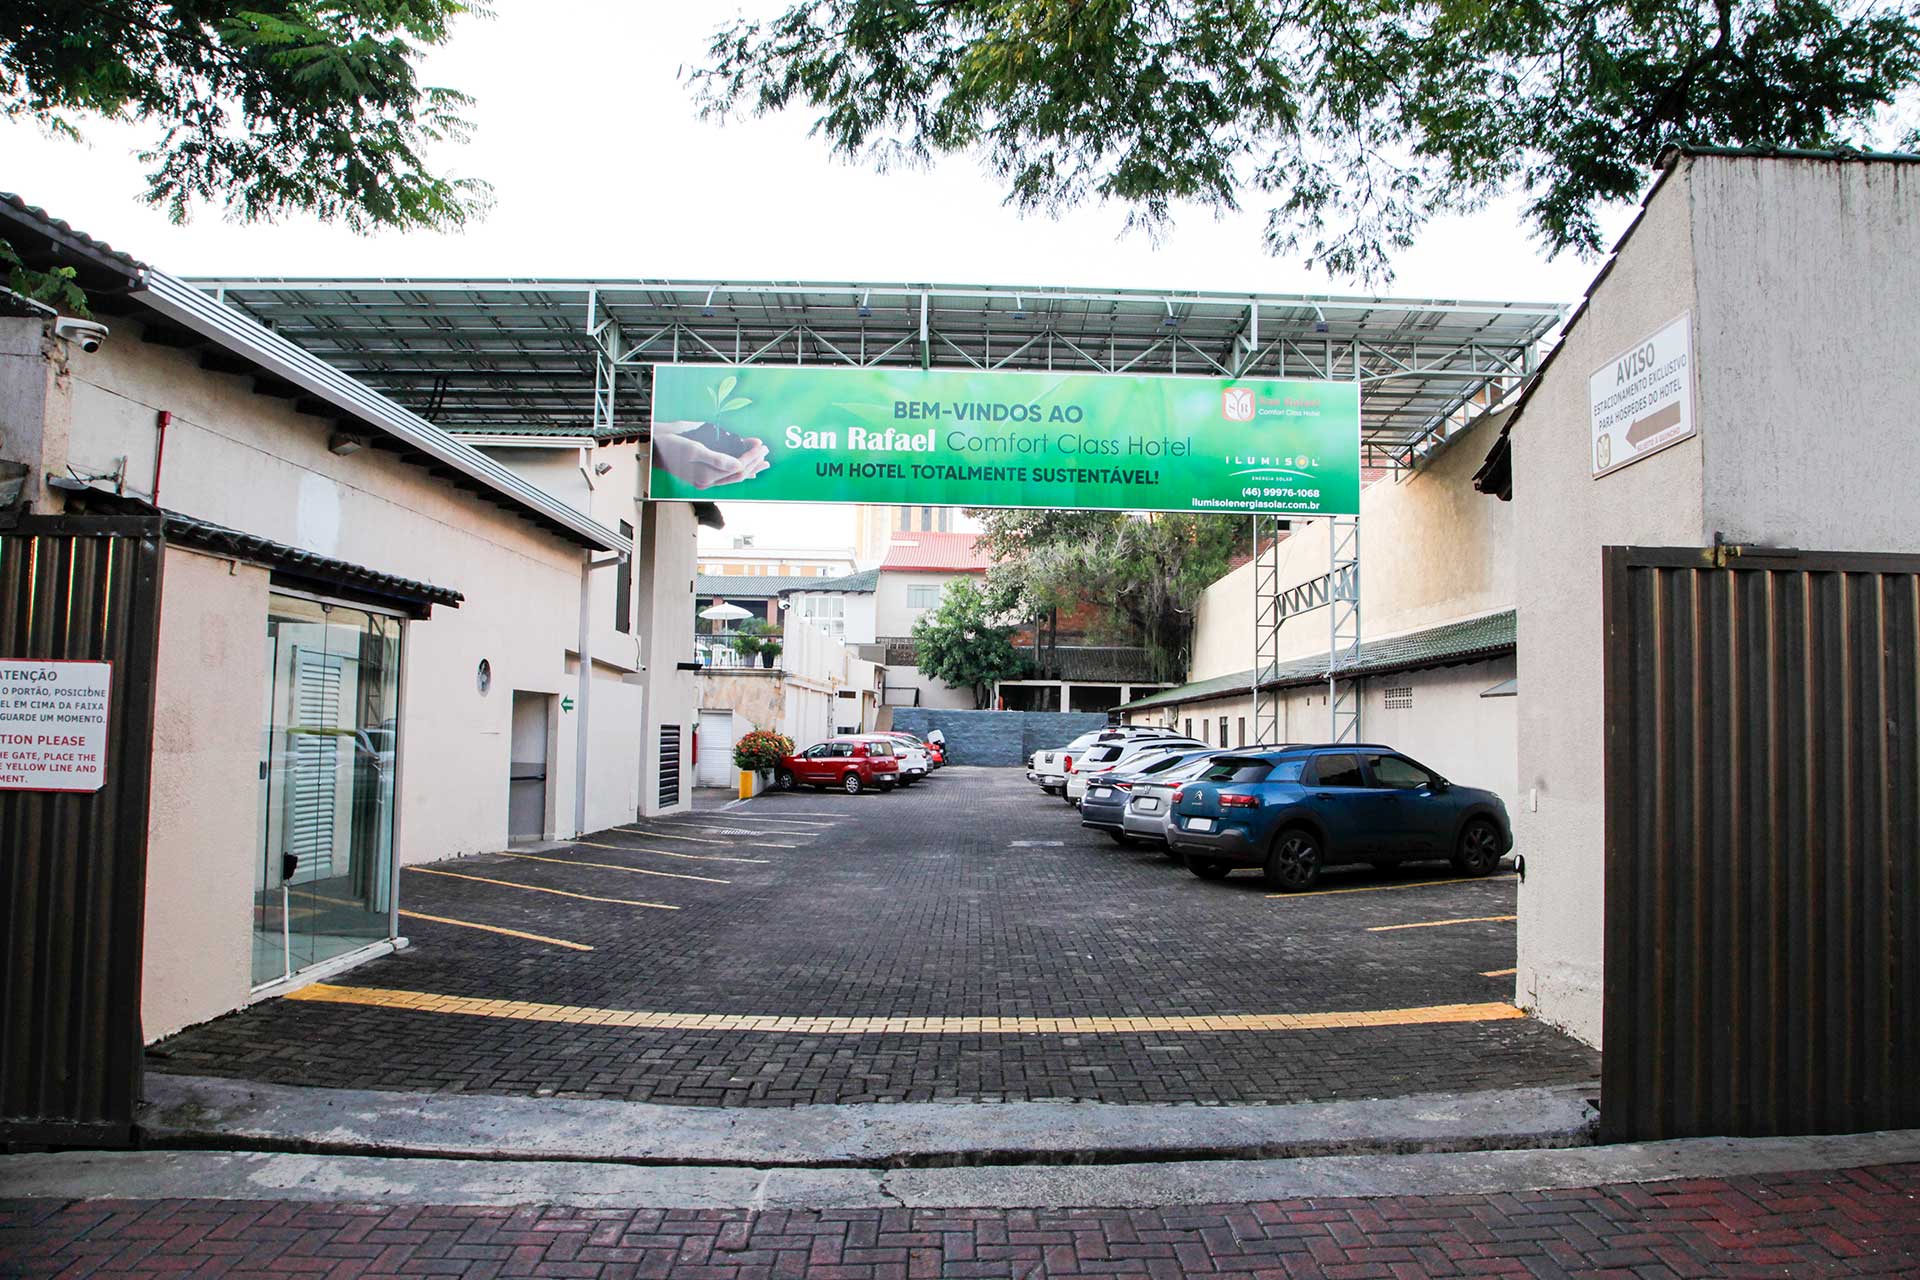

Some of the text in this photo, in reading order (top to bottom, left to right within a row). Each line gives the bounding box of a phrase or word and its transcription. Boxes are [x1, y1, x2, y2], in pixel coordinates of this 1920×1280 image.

[1616, 342, 1655, 386] AVISO
[1594, 353, 1687, 416] ESTACIONAMENTO EXCLUSIVO
[1599, 413, 1614, 431] PARA
[1648, 390, 1658, 405] DO
[1660, 378, 1682, 399] HOTEL
[894, 401, 1083, 424] BEM-VINDOS AO
[785, 425, 1191, 456] San Rafael Comfort Class Hotel
[816, 462, 1159, 485] UM HOTEL TOTALMENTE SUSTENTÁVEL!
[1242, 487, 1320, 499] (46) 99976-1068
[1192, 497, 1320, 510] ilumisolenergiasolar.com.br
[2, 686, 106, 698] O PORTÃO, POSICIONE
[14, 701, 27, 709] EM
[30, 701, 55, 709] CIMA
[58, 702, 72, 710] DA
[75, 702, 104, 711] FAIXA
[40, 714, 54, 722] UM
[57, 714, 106, 723] MOMENTO.
[38, 735, 86, 746] PLEASE
[12, 752, 41, 761] GATE,
[44, 752, 74, 761] PLACE
[78, 753, 96, 762] THE
[6, 762, 46, 771] YELLOW
[49, 764, 73, 772] LINE
[76, 765, 97, 773] AND
